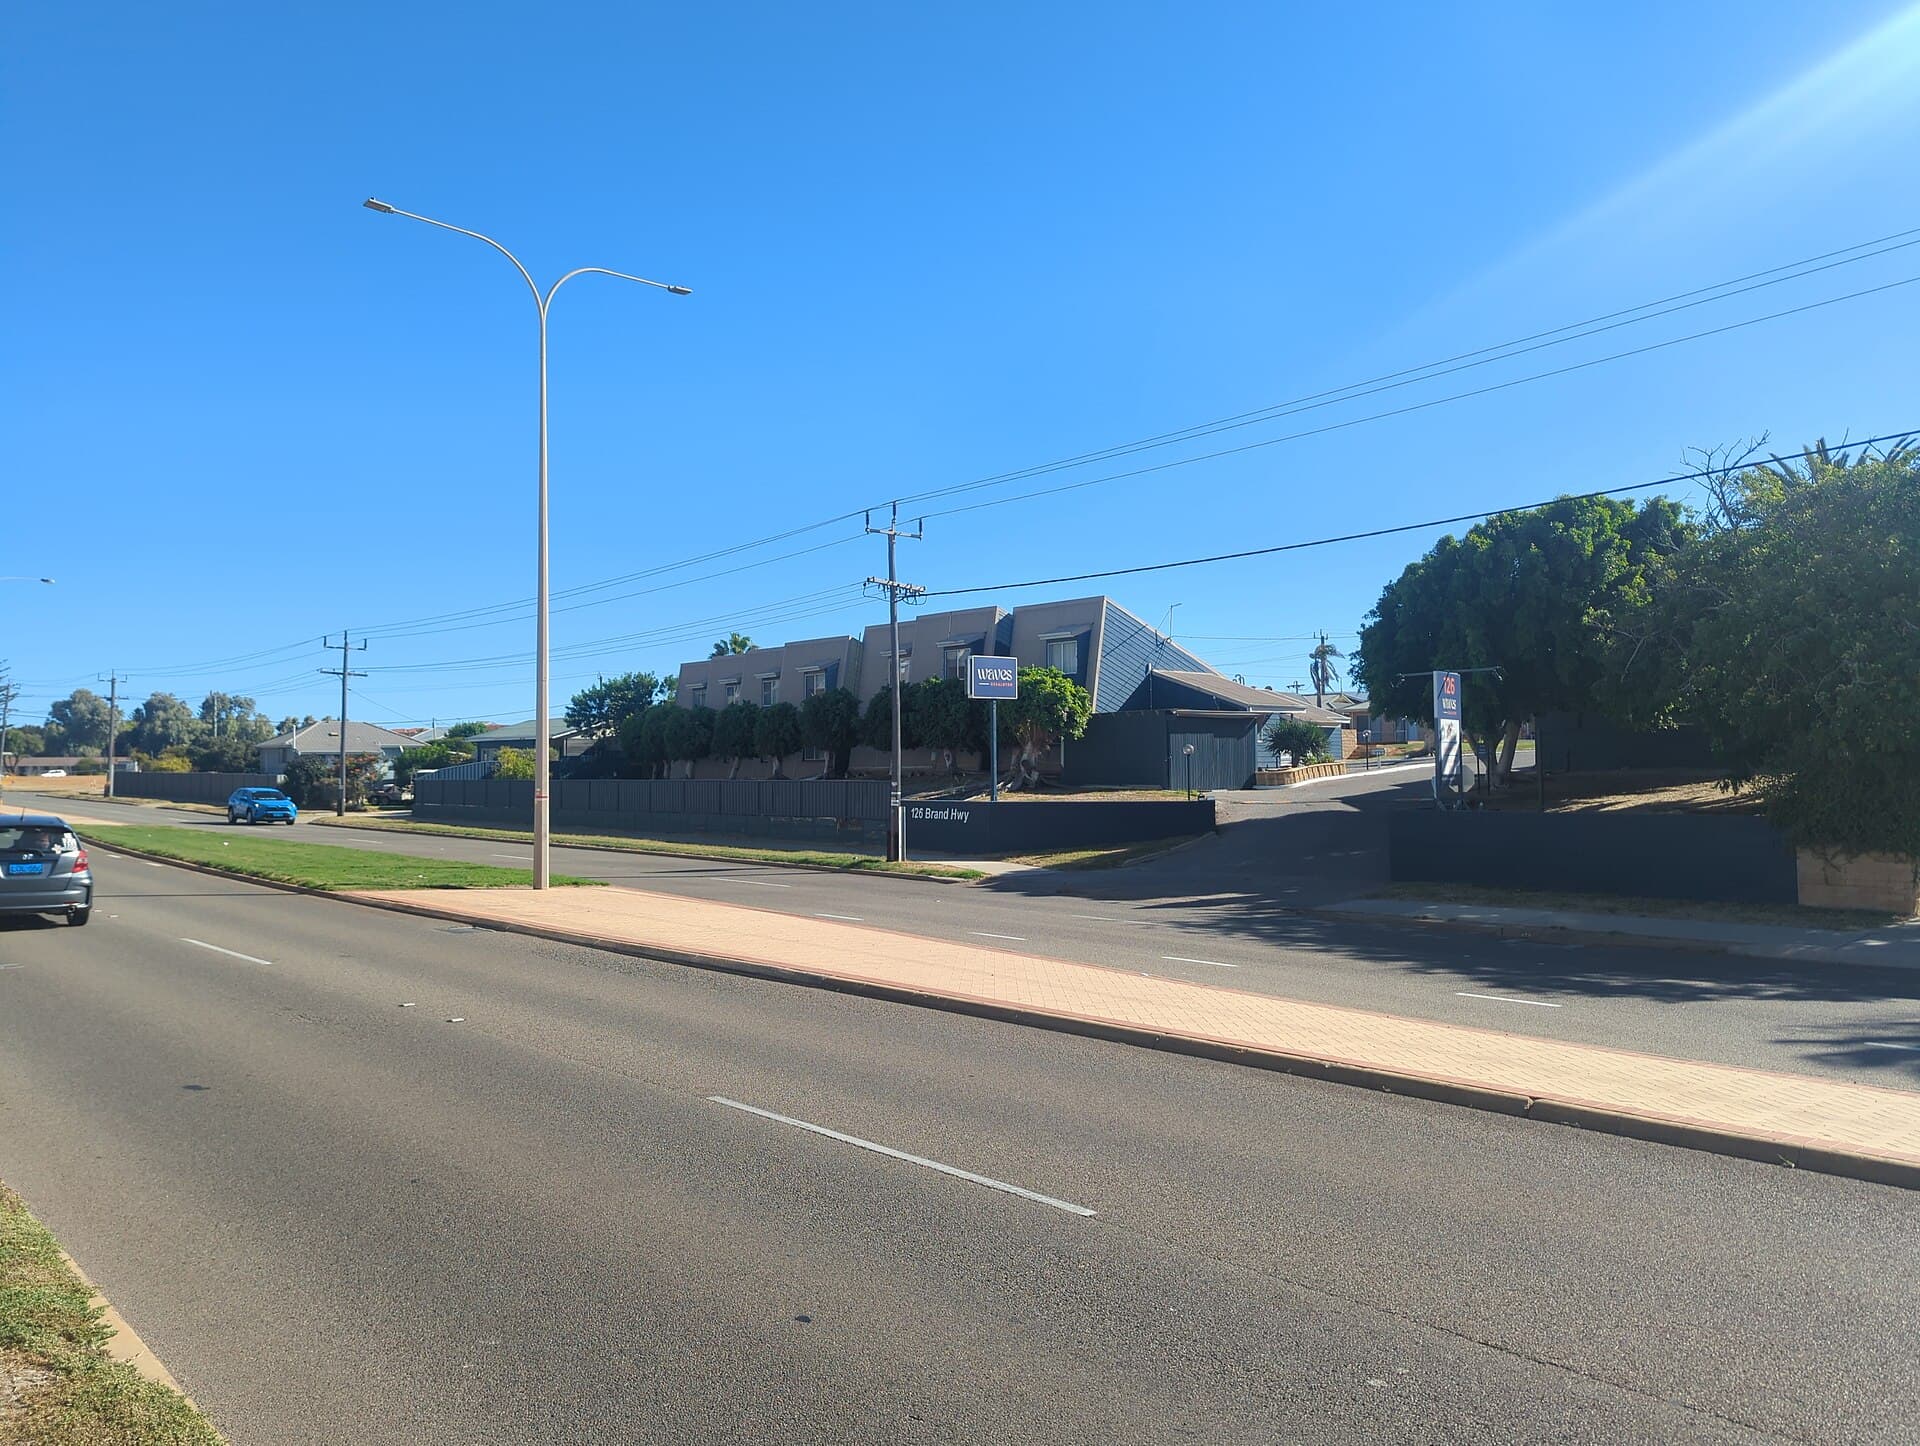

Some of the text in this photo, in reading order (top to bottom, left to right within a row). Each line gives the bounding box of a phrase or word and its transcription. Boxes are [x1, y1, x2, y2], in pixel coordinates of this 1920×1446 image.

[977, 668, 1013, 681] waves
[1443, 676, 1456, 695] 126
[911, 807, 970, 824] 126 Brand Hwy
